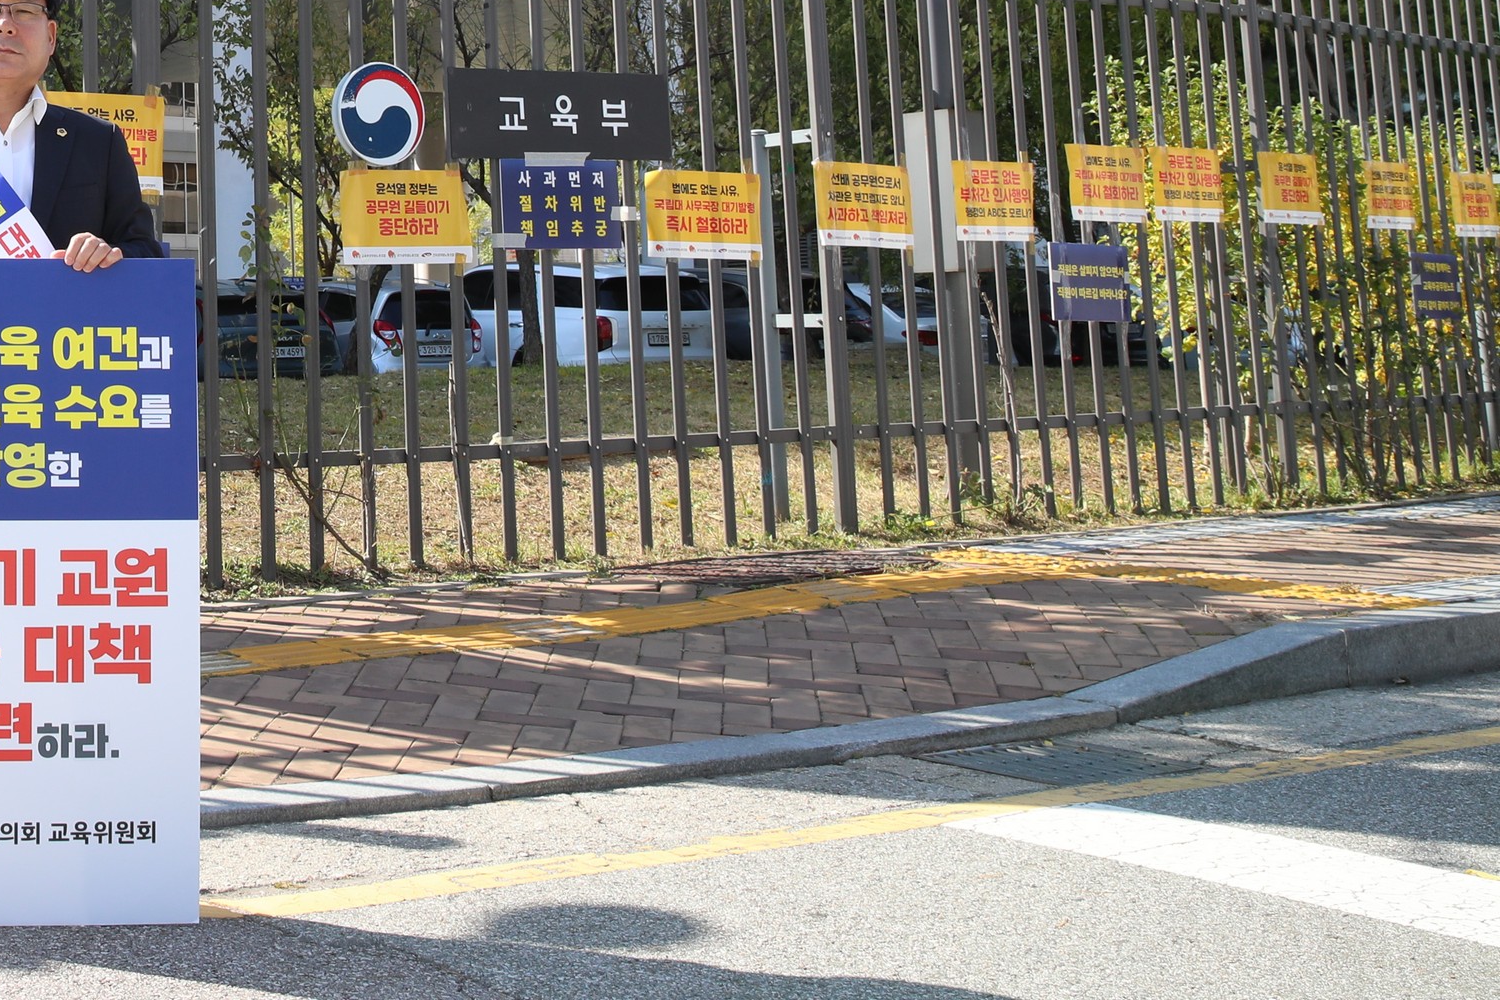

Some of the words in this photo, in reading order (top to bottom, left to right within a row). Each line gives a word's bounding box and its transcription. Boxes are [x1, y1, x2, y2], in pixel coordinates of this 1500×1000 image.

[113, 109, 138, 122] 사유,
[499, 94, 629, 137] 교육부
[1168, 155, 1193, 169] 공문도
[1195, 156, 1211, 170] 없는
[831, 173, 850, 185] 선배
[852, 174, 901, 189] 공무원으로서
[971, 169, 999, 184] 공문도
[1002, 170, 1021, 185] 없는
[1159, 171, 1185, 186] 부처간
[376, 182, 406, 195] 윤석열
[409, 183, 438, 195] 정부는
[672, 183, 698, 195] 법에도
[700, 184, 717, 195] 없는
[720, 185, 739, 196] 사유,
[828, 190, 852, 202] 차관은
[960, 187, 990, 202] 부처간
[992, 188, 1031, 203] 인사행위
[1103, 184, 1139, 200] 철회하라
[1281, 188, 1309, 203] 중단하라
[366, 200, 401, 214] 공무원
[404, 200, 450, 214] 길들이기
[654, 199, 683, 211] 국립대
[686, 200, 719, 212] 사무국장
[722, 202, 755, 214] 대기발령
[828, 207, 869, 222] 사과하고
[871, 209, 908, 225] 책임져라
[379, 218, 438, 236] 중단하라
[666, 215, 692, 232] 즉시
[696, 216, 748, 235] 철회하라
[52, 326, 173, 370] 여건과
[287, 347, 304, 357] 4591
[439, 345, 452, 354] 392
[54, 384, 172, 429] 수요를
[57, 548, 168, 607] 교원
[24, 622, 151, 684] 대책
[48, 821, 157, 845] 교육위원회
